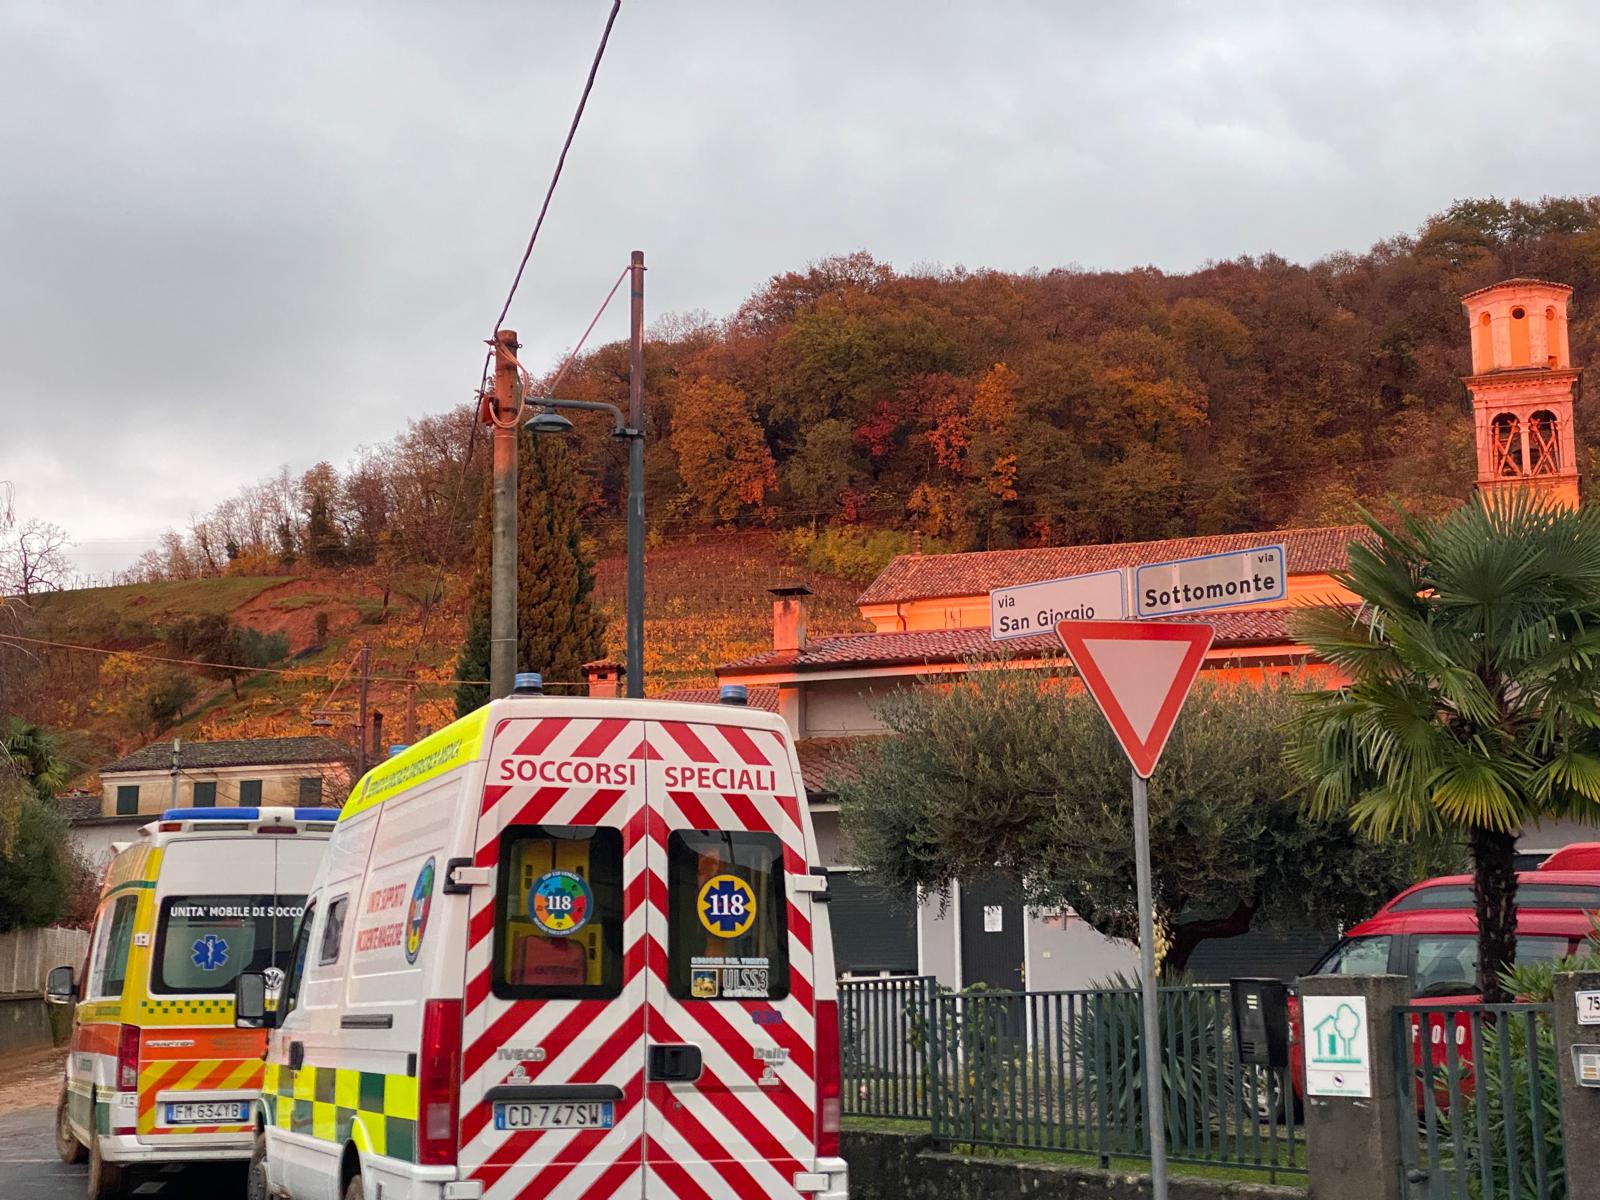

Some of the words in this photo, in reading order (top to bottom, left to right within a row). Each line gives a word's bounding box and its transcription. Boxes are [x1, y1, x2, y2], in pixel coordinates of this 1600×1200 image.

[1258, 553, 1274, 563] via
[1145, 573, 1275, 607] Sottomonte
[998, 595, 1015, 608] via
[999, 615, 1030, 632] San
[1037, 604, 1095, 626] Giorgio
[500, 759, 636, 786] SOCCORSI
[665, 766, 776, 791] SPECIALI
[547, 895, 572, 910] 118
[710, 893, 745, 916] 118
[170, 906, 207, 917] UNITA'
[209, 906, 250, 917] MOBILE
[252, 906, 265, 917] DI
[722, 968, 769, 991] ULSS3
[497, 1047, 545, 1061] IVECO
[755, 1047, 789, 1060] Daily
